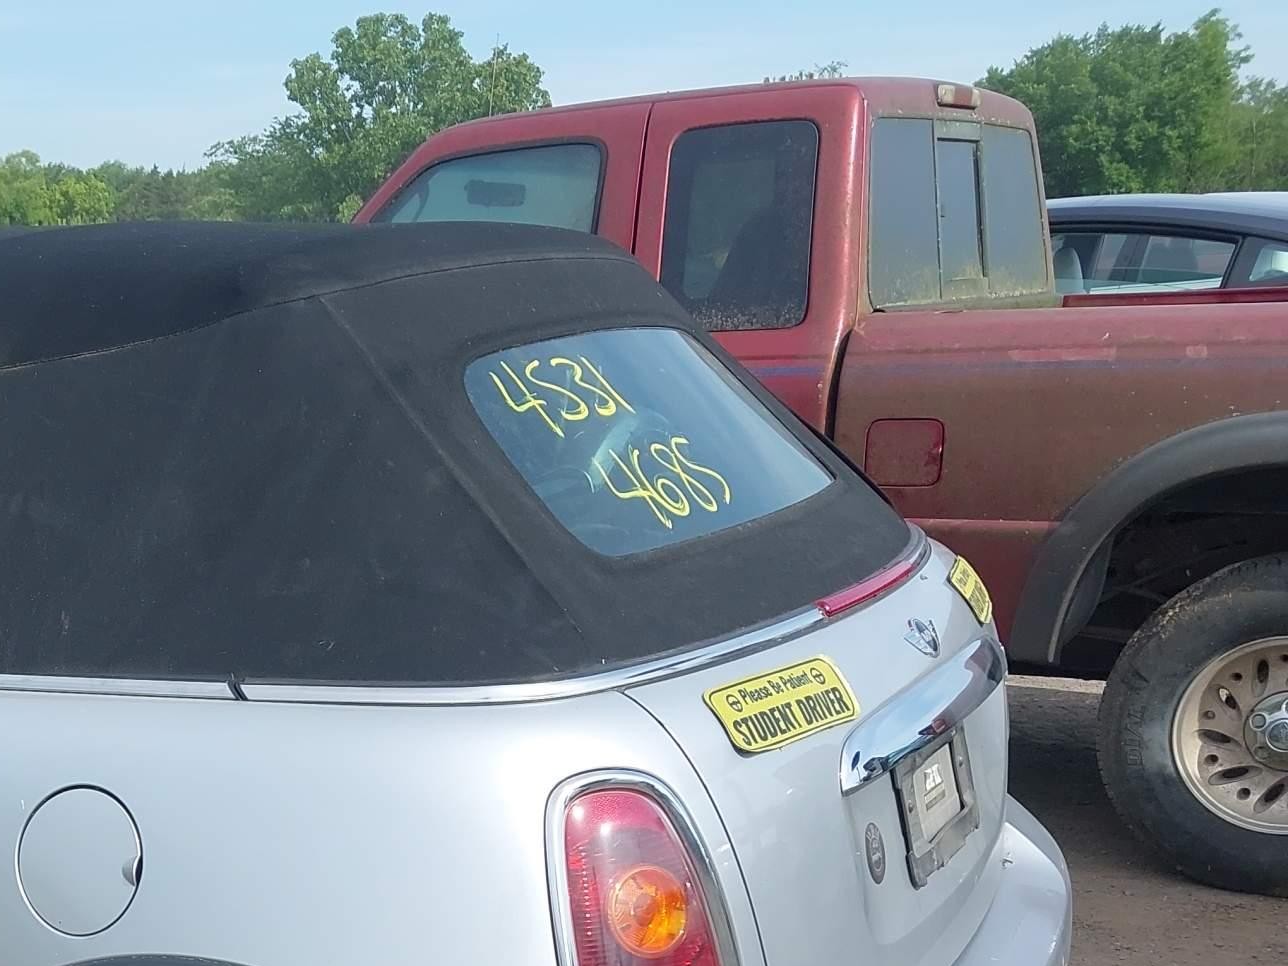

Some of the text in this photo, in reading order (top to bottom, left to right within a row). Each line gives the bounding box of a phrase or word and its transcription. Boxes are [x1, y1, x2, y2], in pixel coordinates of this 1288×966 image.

[489, 355, 637, 438] 4531
[592, 435, 731, 530] 4685
[732, 686, 851, 746] STUDENT DRIVER
[738, 670, 814, 705] Please Be Patient
